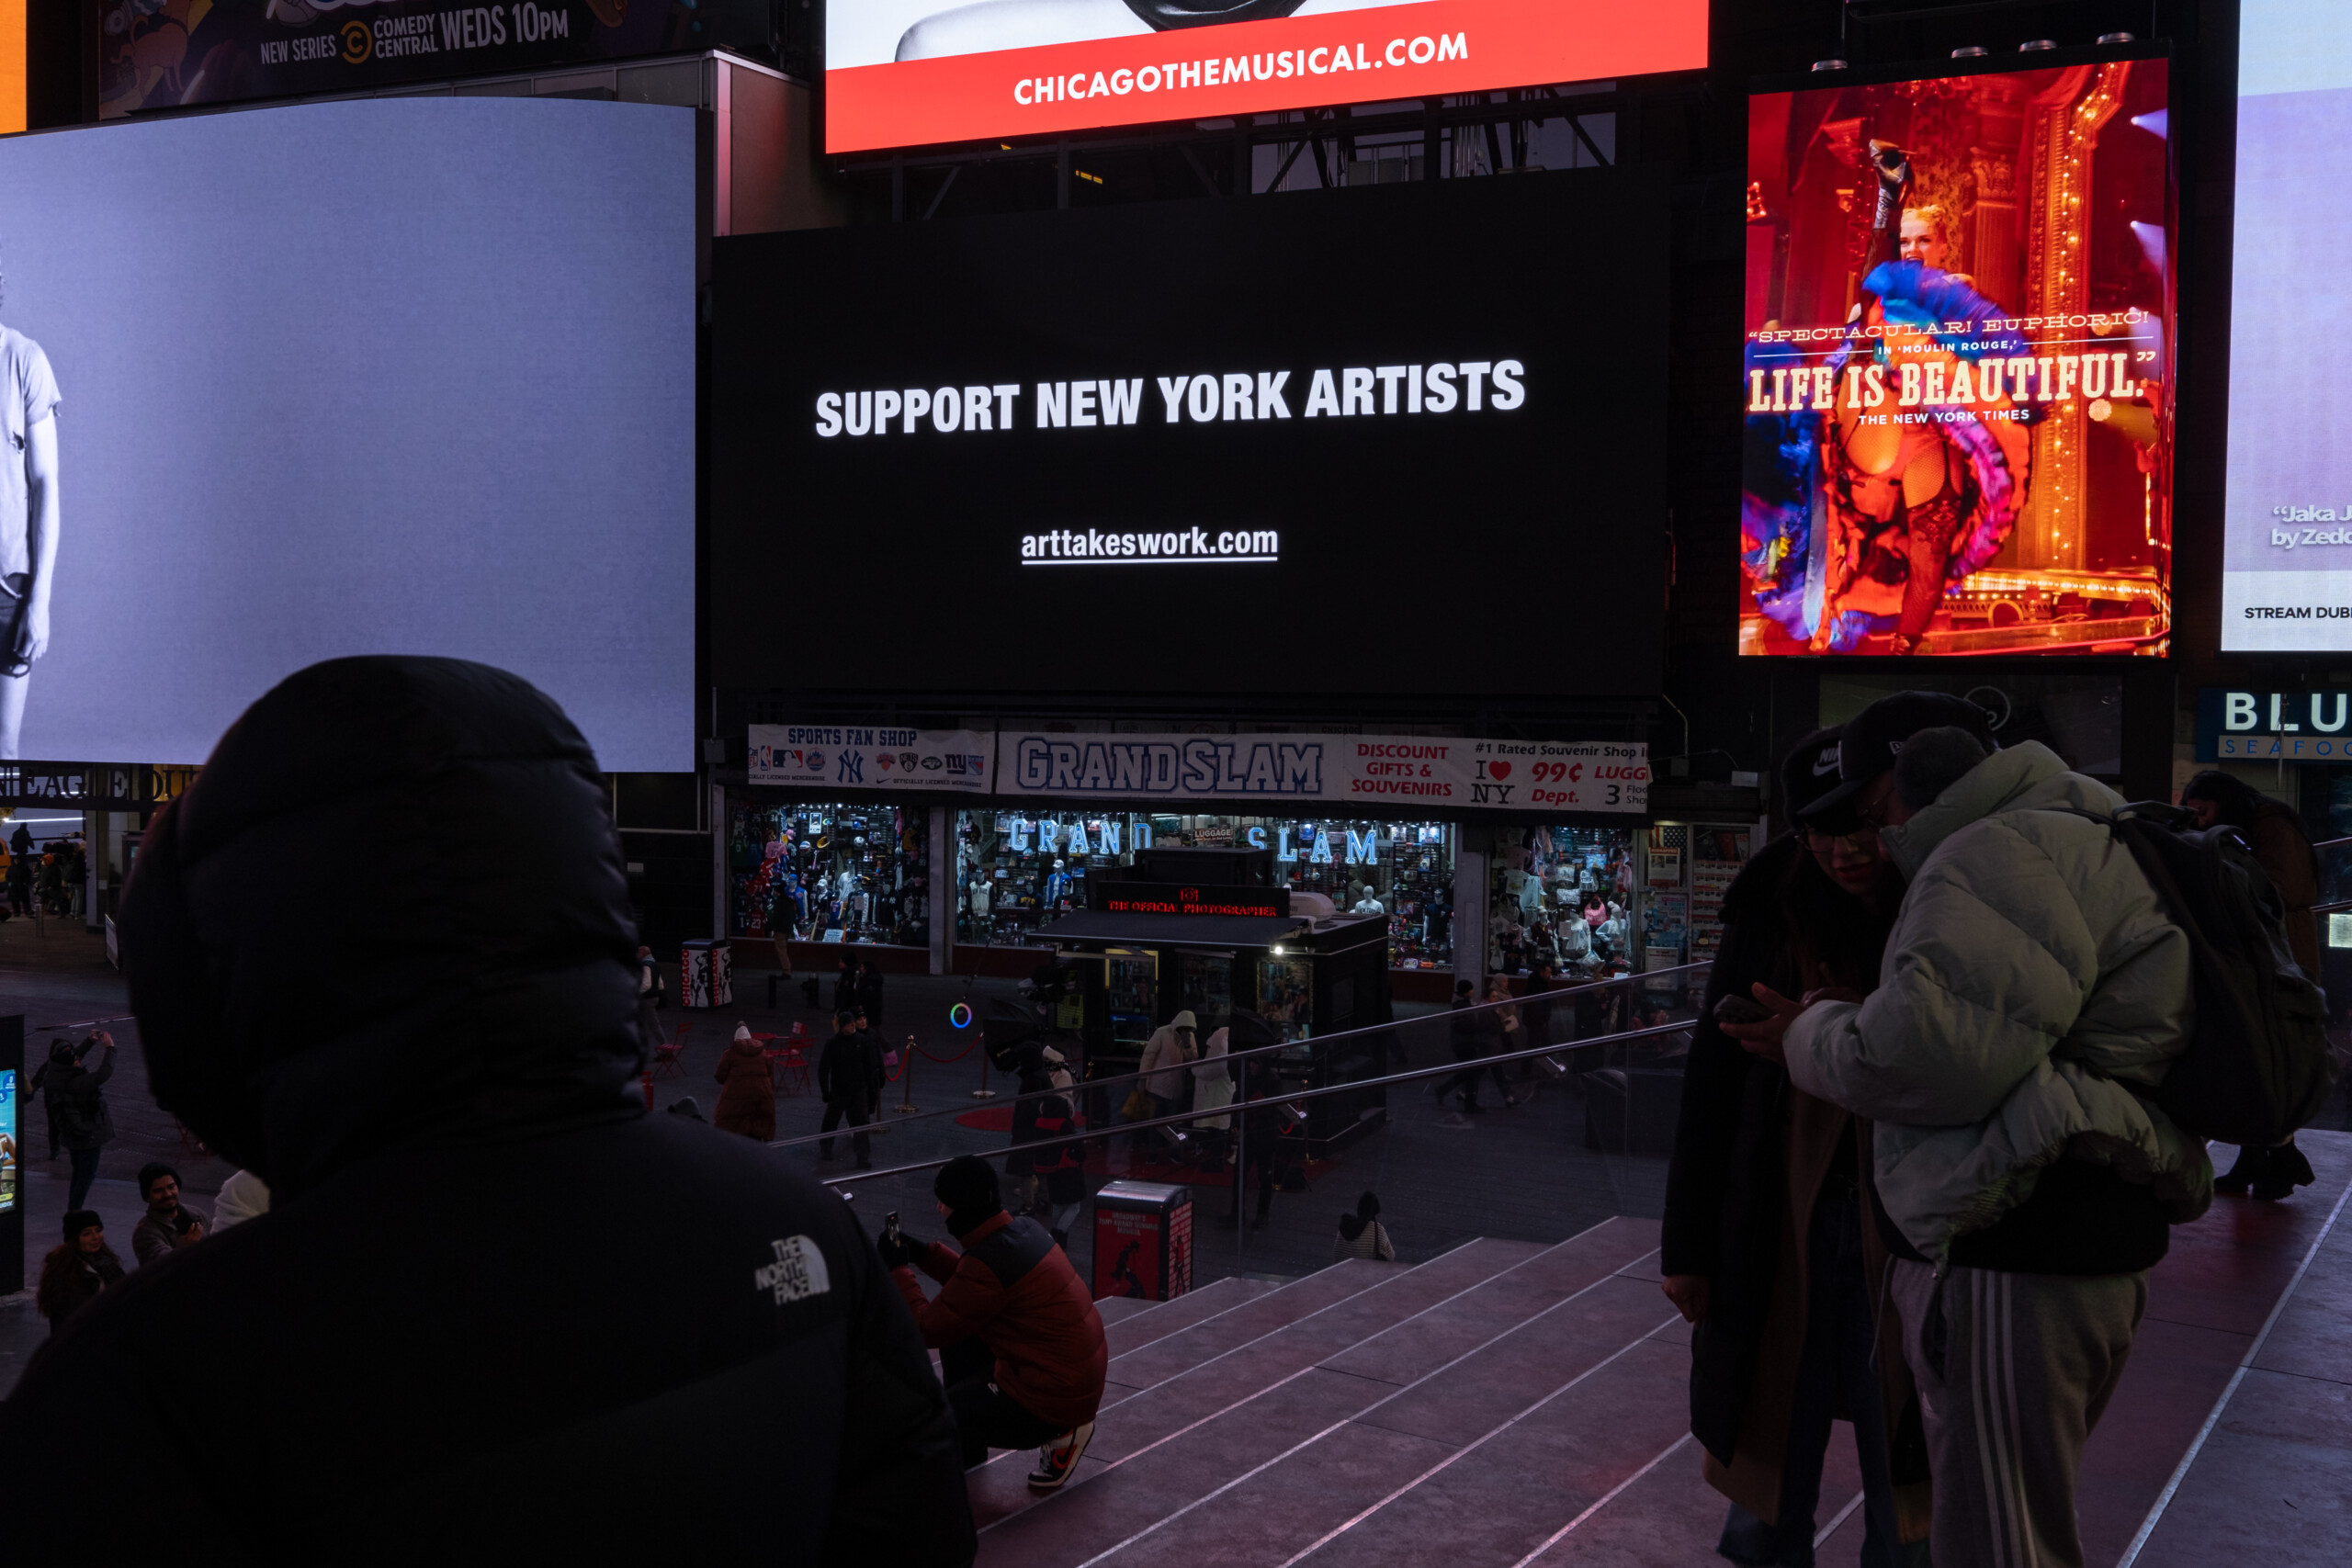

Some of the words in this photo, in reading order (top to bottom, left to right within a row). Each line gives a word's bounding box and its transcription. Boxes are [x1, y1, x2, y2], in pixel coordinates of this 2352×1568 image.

[373, 14, 436, 39] COMEDY
[440, 6, 506, 51] WEDS
[512, 2, 569, 42] 10PM
[261, 41, 288, 64] NEW
[292, 34, 336, 62] SERIES
[374, 34, 438, 59] CENTRAL
[1013, 31, 1468, 106] CHICAGOTHEMUSICAL.COM
[1982, 311, 2149, 332] EUPHORIC!
[1878, 345, 1892, 355] IN
[815, 383, 1021, 437] SUPPORT
[1036, 378, 1144, 428] NEW
[1158, 370, 1292, 423] YORK
[1304, 359, 1525, 418] ARTISTS
[1749, 367, 1833, 412] LIFE
[1847, 365, 1885, 409] IS
[1859, 414, 1889, 425] THE
[1894, 412, 1929, 424] NEW
[1935, 412, 1977, 423] YORK
[1983, 409, 2030, 422] TIMES
[1021, 526, 1278, 558] arttakeswork.com
[2271, 528, 2301, 549] by
[2245, 607, 2312, 619] STREAM
[2316, 606, 2352, 619] DUB
[2225, 693, 2346, 732] BLU
[788, 728, 842, 745] SPORTS
[846, 728, 873, 745] FAN
[879, 731, 917, 746] SHOP
[1357, 743, 1449, 760] DISCOUNT
[1475, 743, 1492, 754] #1
[1498, 744, 1536, 756] Rated
[1541, 745, 1599, 757] Souvenir
[1604, 746, 1636, 760] Shop
[1366, 762, 1414, 776] GIFTS
[1419, 763, 1431, 777] &
[1476, 760, 1487, 779] I
[1532, 761, 1583, 783] 99¢
[1595, 765, 1647, 781] LUGG
[1351, 780, 1452, 796] SOUVENIRS
[1470, 784, 1515, 805] NY
[1532, 788, 1580, 806] Dept.
[1605, 784, 1621, 805] 3
[1010, 818, 1151, 855] GRAND
[1248, 825, 1378, 865] SLAM
[1194, 829, 1231, 837] LUGGAGE
[1108, 900, 1129, 911] THE
[1183, 903, 1277, 917] PHOTOGRAPHER
[682, 949, 691, 1006] CHICAGO
[770, 1236, 802, 1261] THE
[754, 1255, 808, 1292] NORTH
[774, 1276, 809, 1306] FACE
